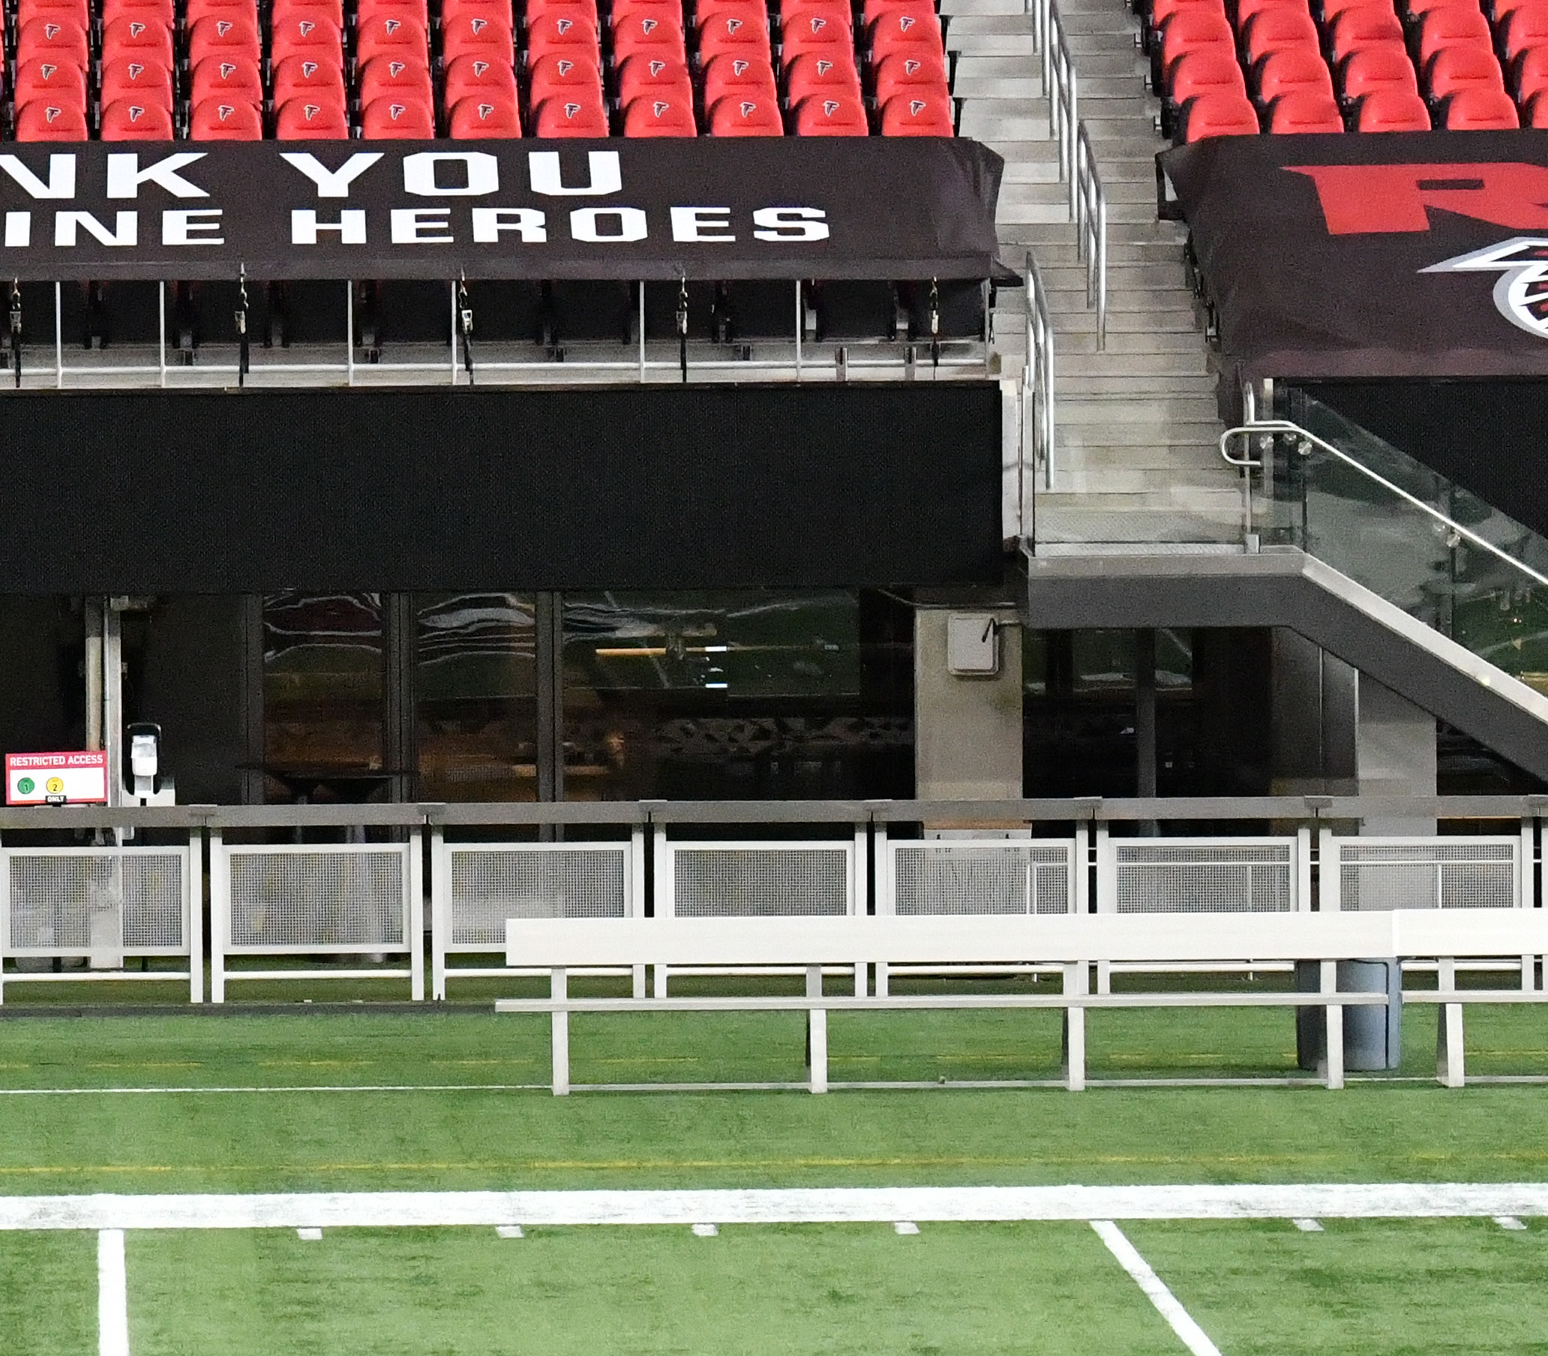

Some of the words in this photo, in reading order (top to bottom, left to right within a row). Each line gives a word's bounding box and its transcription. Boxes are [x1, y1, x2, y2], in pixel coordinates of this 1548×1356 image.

[280, 150, 623, 198] YOU
[291, 206, 830, 245] HEROES
[9, 756, 66, 767] RESTRICTED
[68, 754, 103, 765] ACCESS
[47, 795, 65, 803] ONLY
